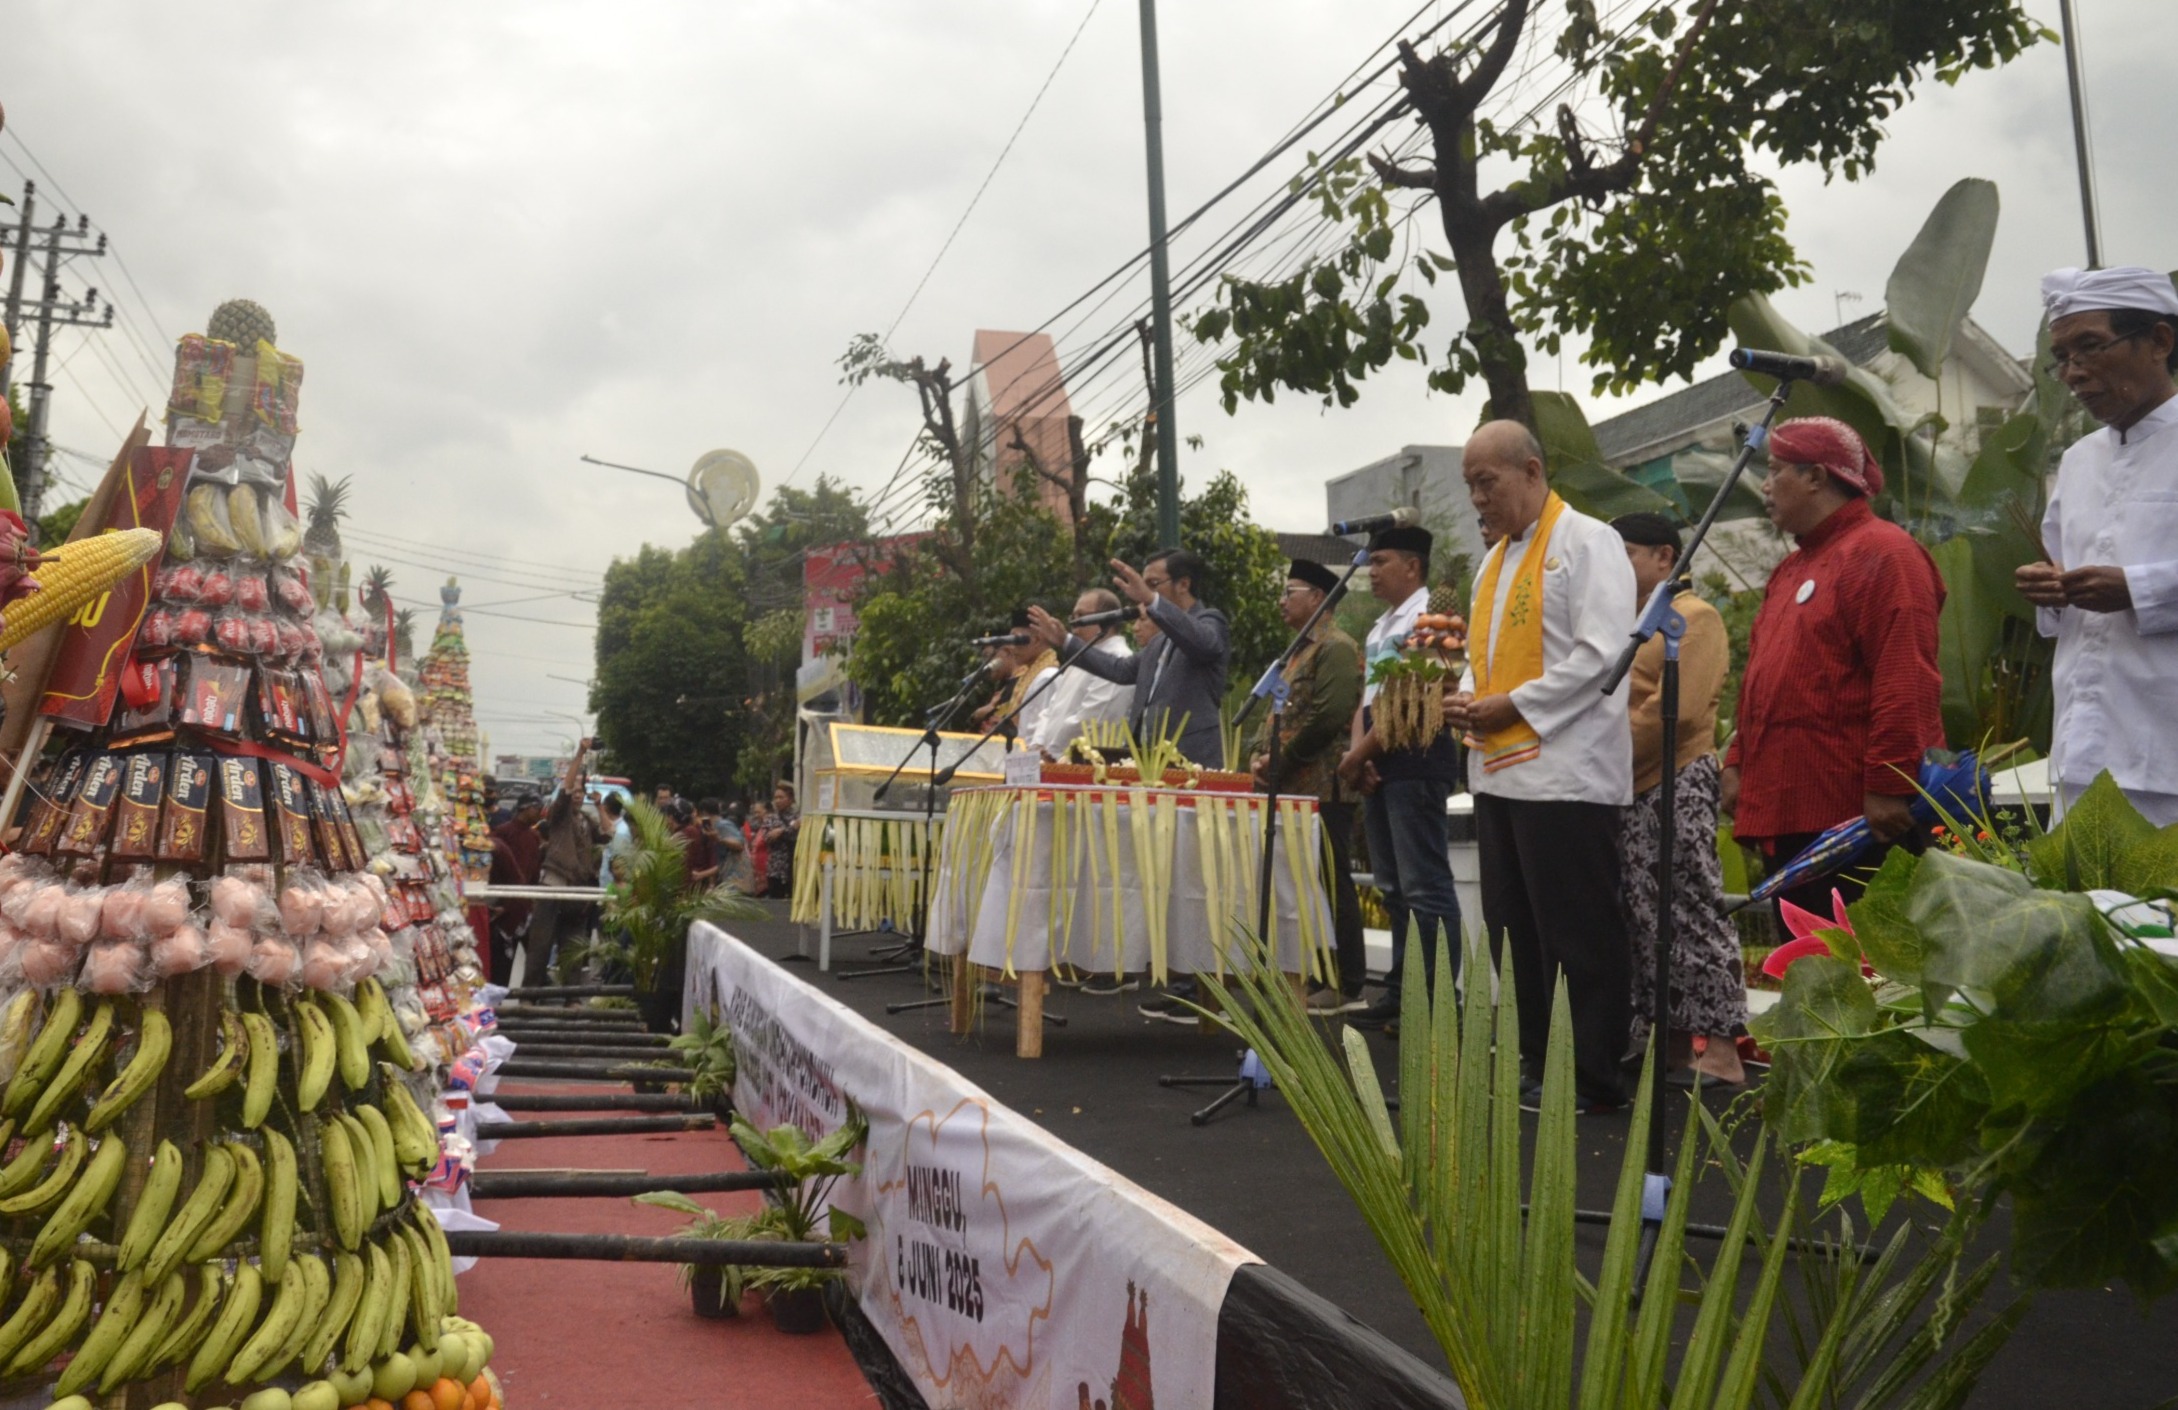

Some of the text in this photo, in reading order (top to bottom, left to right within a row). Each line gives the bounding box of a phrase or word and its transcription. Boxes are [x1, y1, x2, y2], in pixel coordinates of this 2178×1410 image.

[56, 755, 81, 796] Arden
[86, 755, 113, 798] Arden
[131, 753, 152, 797] Arden
[177, 755, 198, 799] Arden
[226, 757, 246, 801] Arden
[275, 763, 294, 806] Arden
[907, 1164, 967, 1250] MINGGU,
[907, 1239, 942, 1306] JUNI
[945, 1248, 985, 1324] 2025
